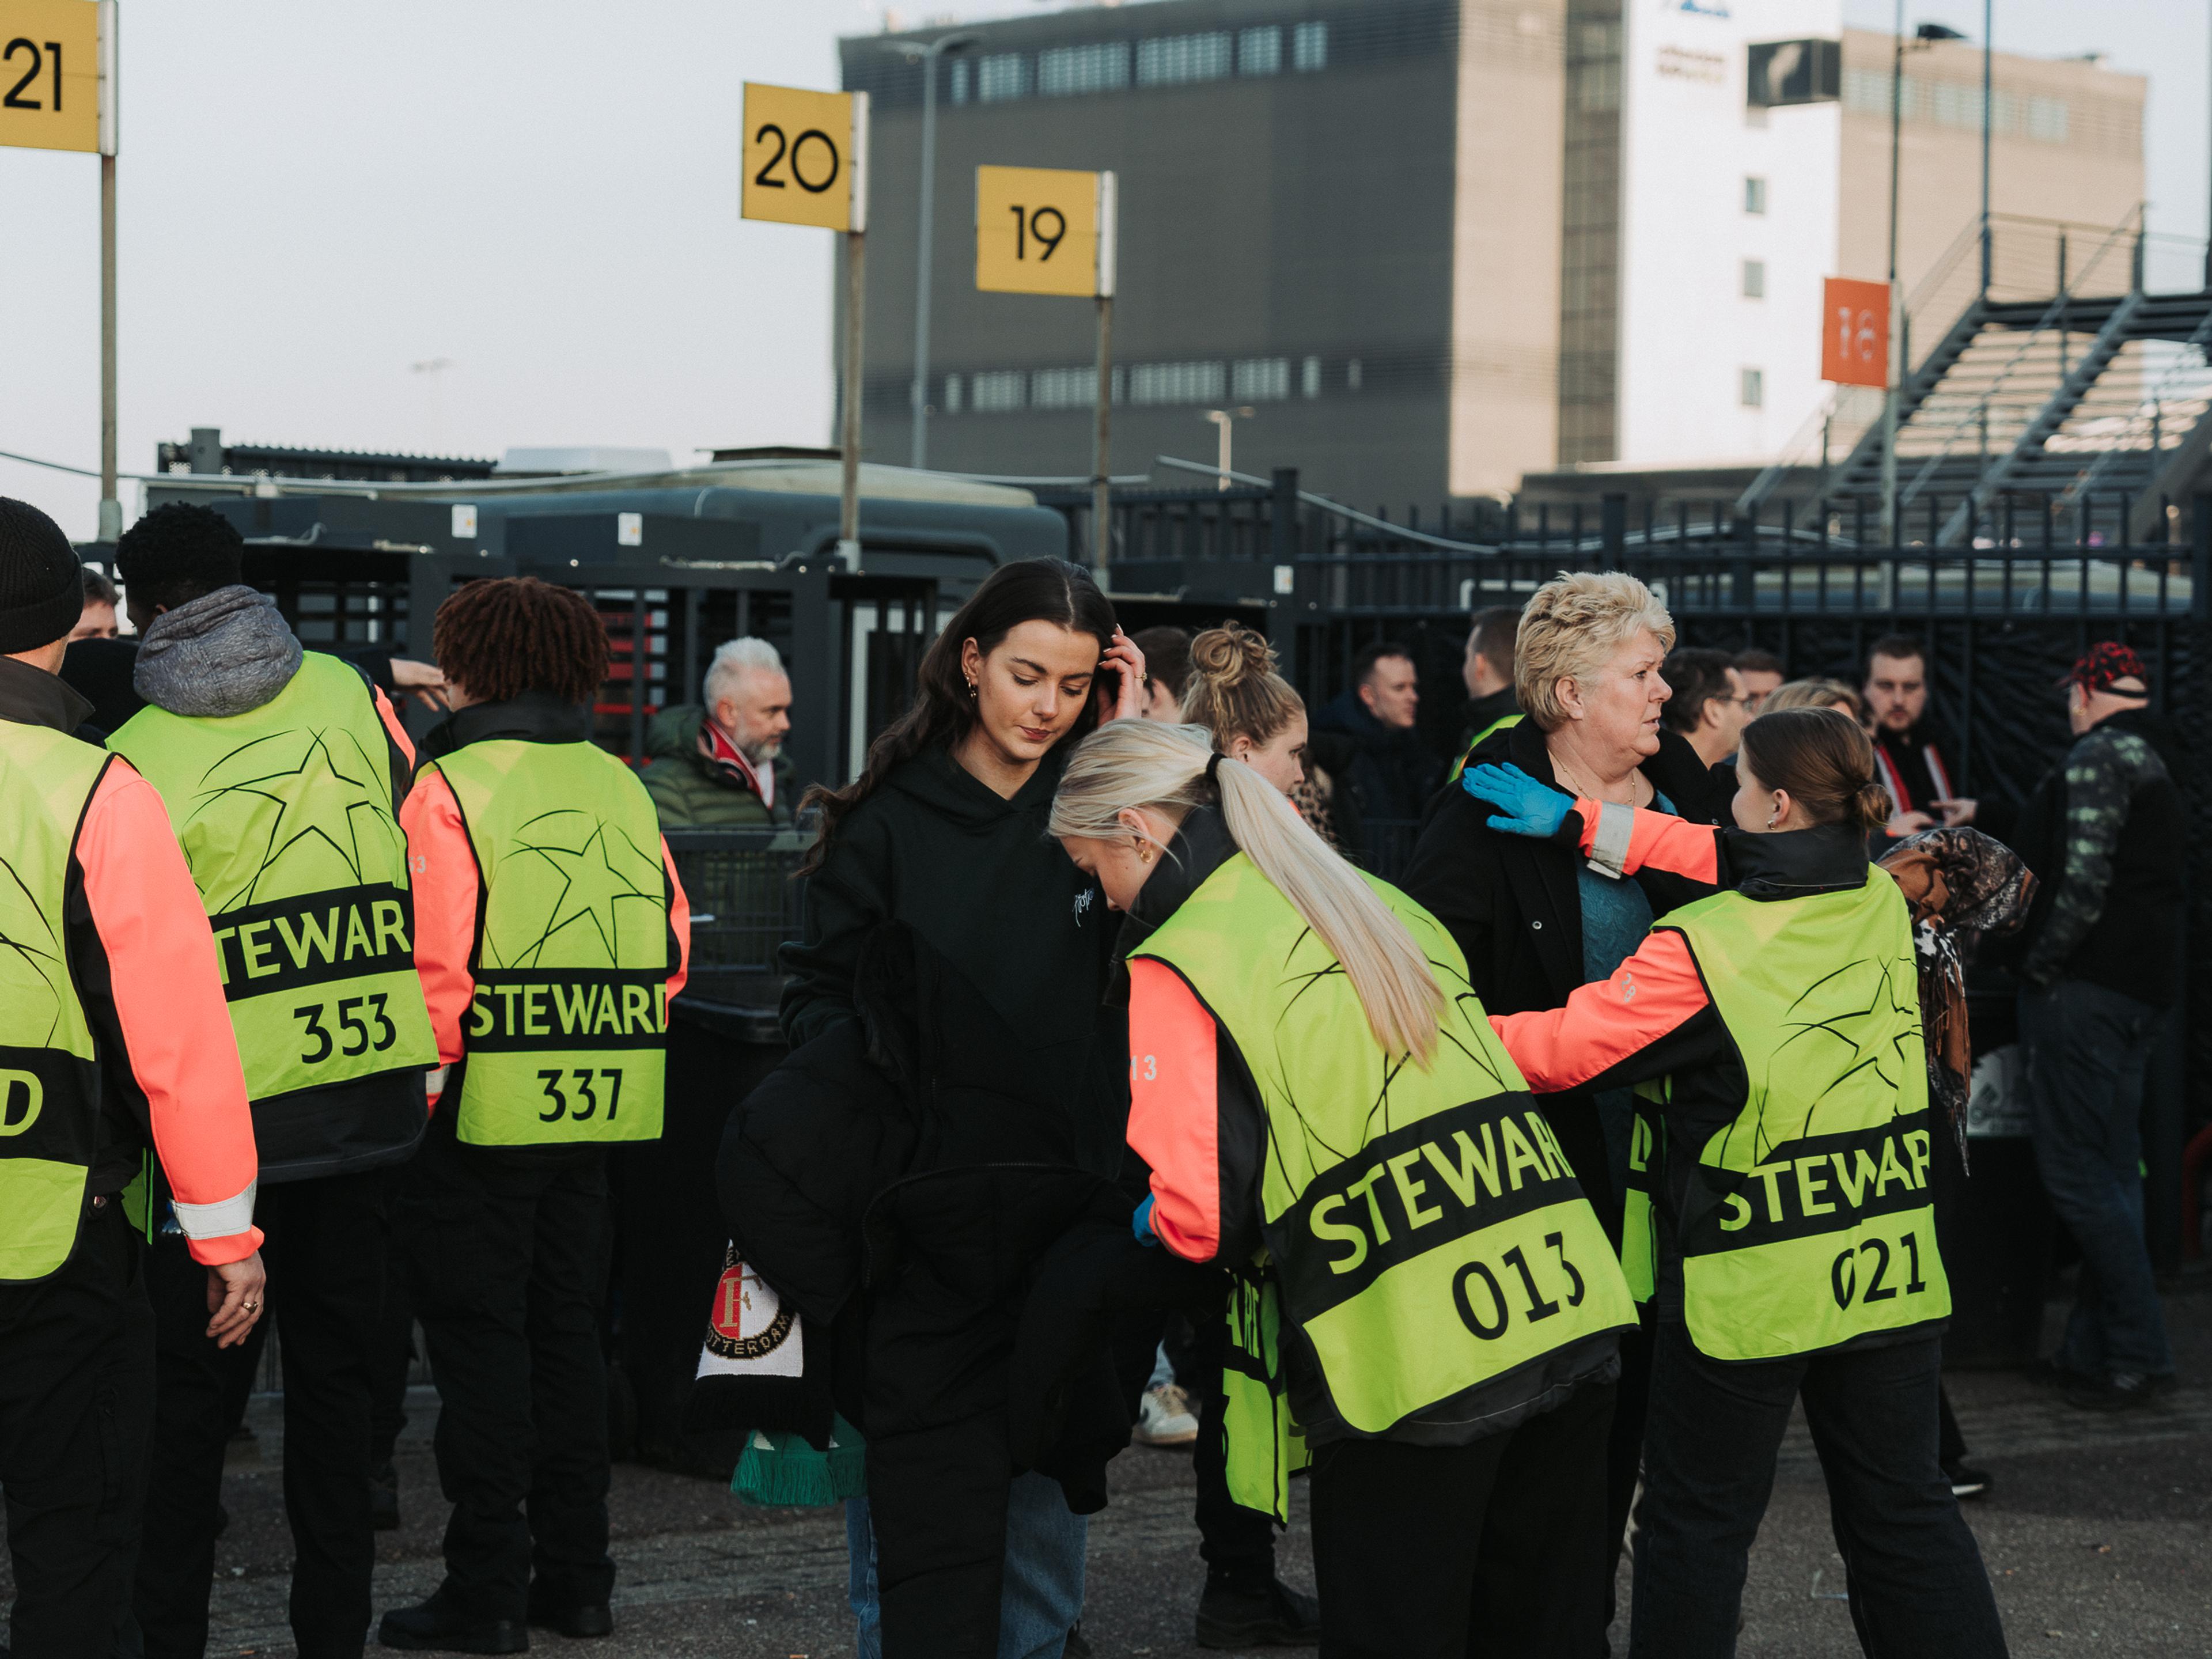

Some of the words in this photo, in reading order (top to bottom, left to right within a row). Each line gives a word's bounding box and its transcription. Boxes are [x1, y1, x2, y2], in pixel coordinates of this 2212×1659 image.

[2, 37, 62, 112] 21
[755, 123, 839, 194] 20
[1010, 205, 1066, 261] 19
[294, 993, 396, 1063] 353
[536, 1069, 623, 1123] 337
[1309, 1111, 1577, 1275] STEWAR
[1452, 1231, 1585, 1340] 013
[1831, 1232, 1926, 1311] 021
